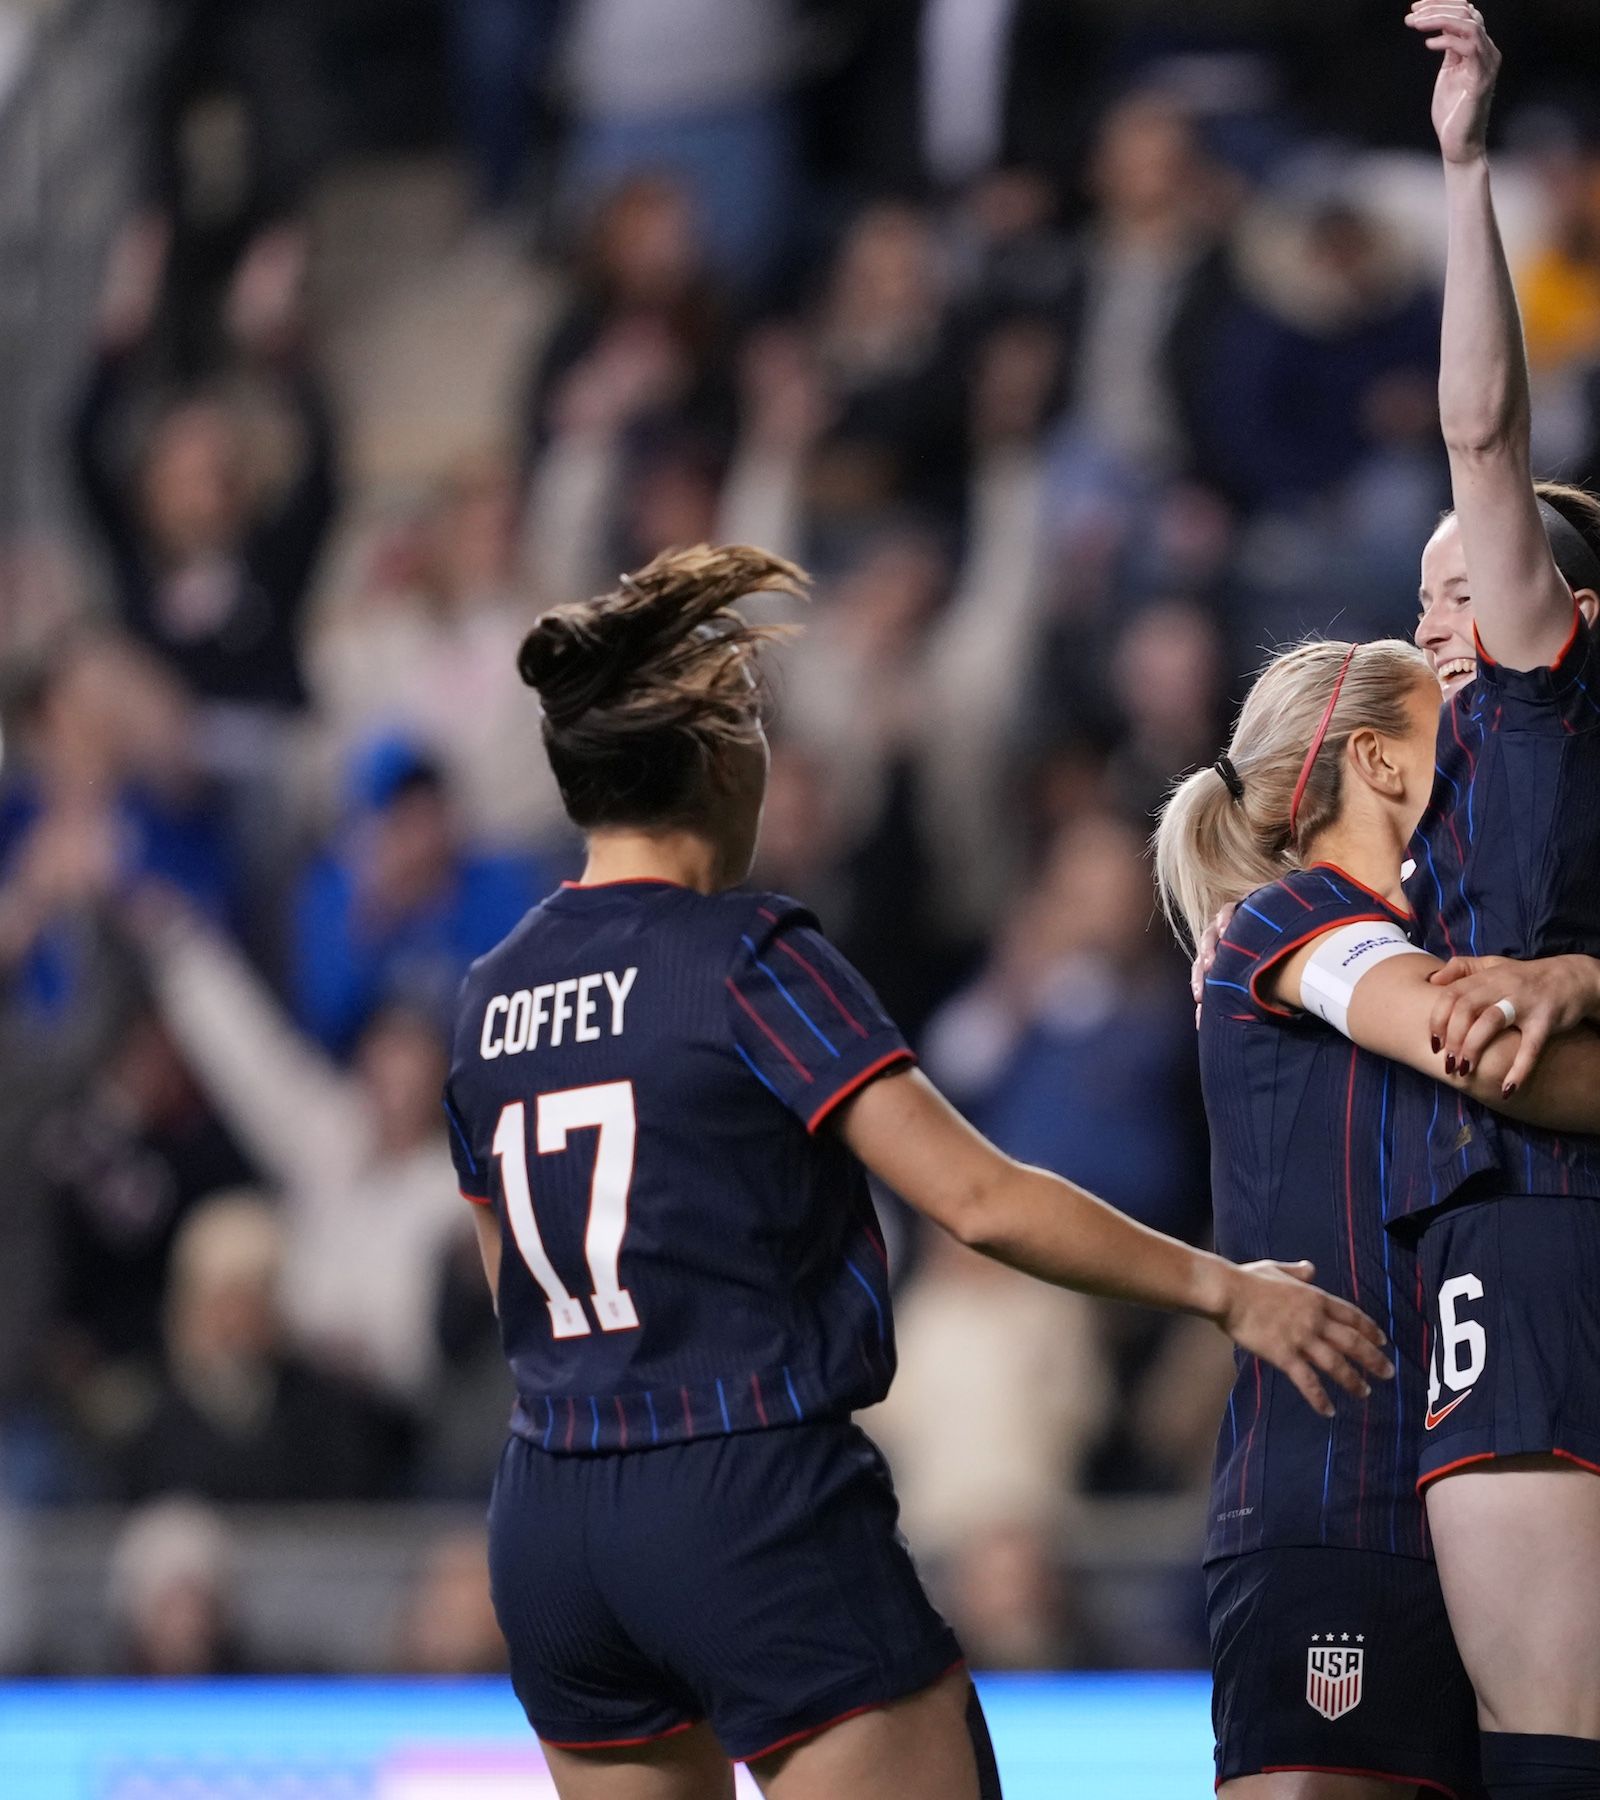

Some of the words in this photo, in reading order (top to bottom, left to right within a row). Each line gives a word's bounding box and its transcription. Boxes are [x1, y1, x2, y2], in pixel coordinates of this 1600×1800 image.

[1348, 939, 1375, 953] USA
[479, 967, 638, 1060] COFFEY
[492, 1081, 640, 1338] 17
[1312, 1651, 1360, 1678] USA
